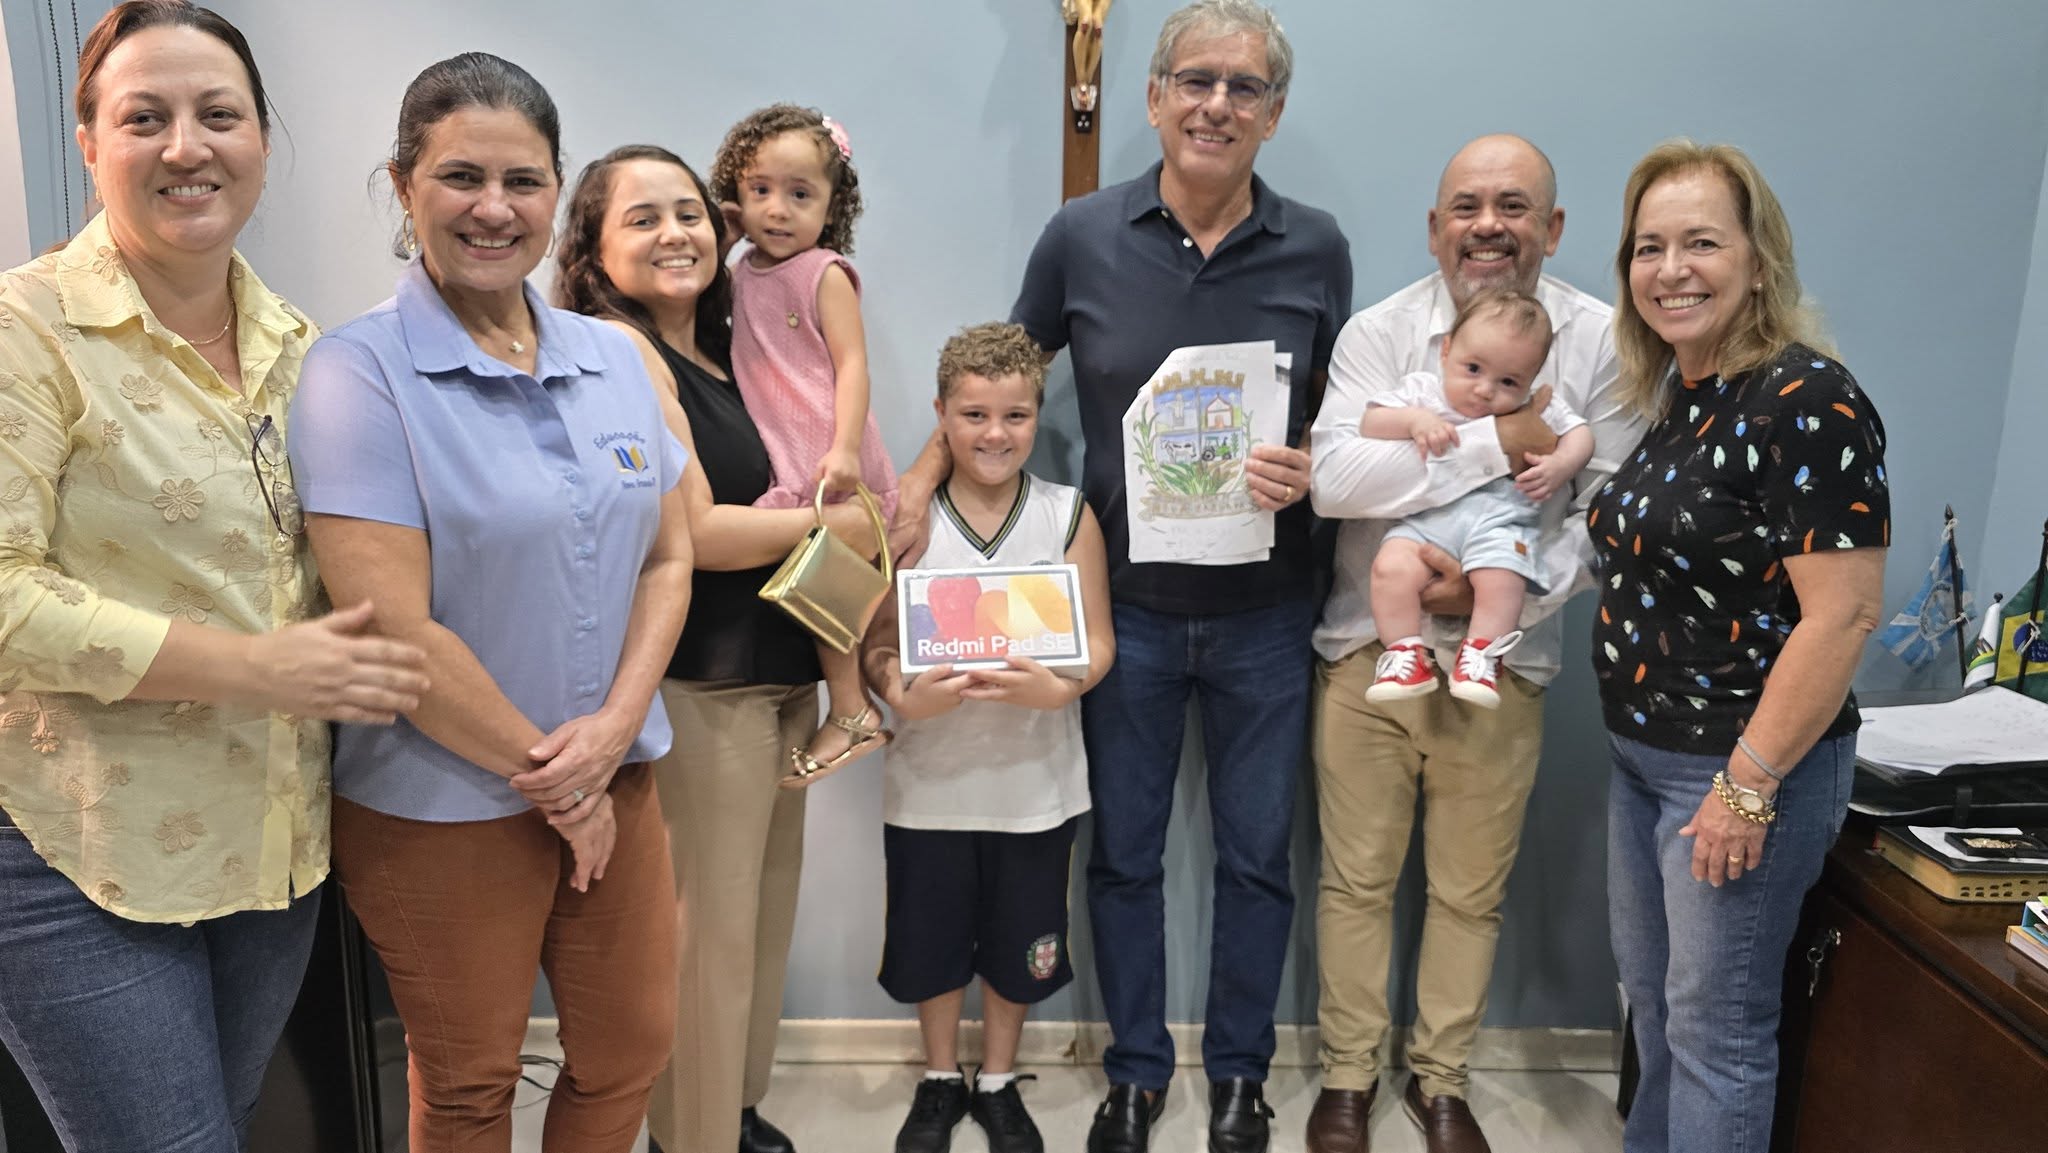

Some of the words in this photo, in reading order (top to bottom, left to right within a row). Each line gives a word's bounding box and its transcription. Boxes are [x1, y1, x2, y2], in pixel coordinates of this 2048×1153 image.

[917, 637, 985, 657] Redmi
[991, 634, 1035, 653] Pad
[1042, 633, 1070, 650] SE
